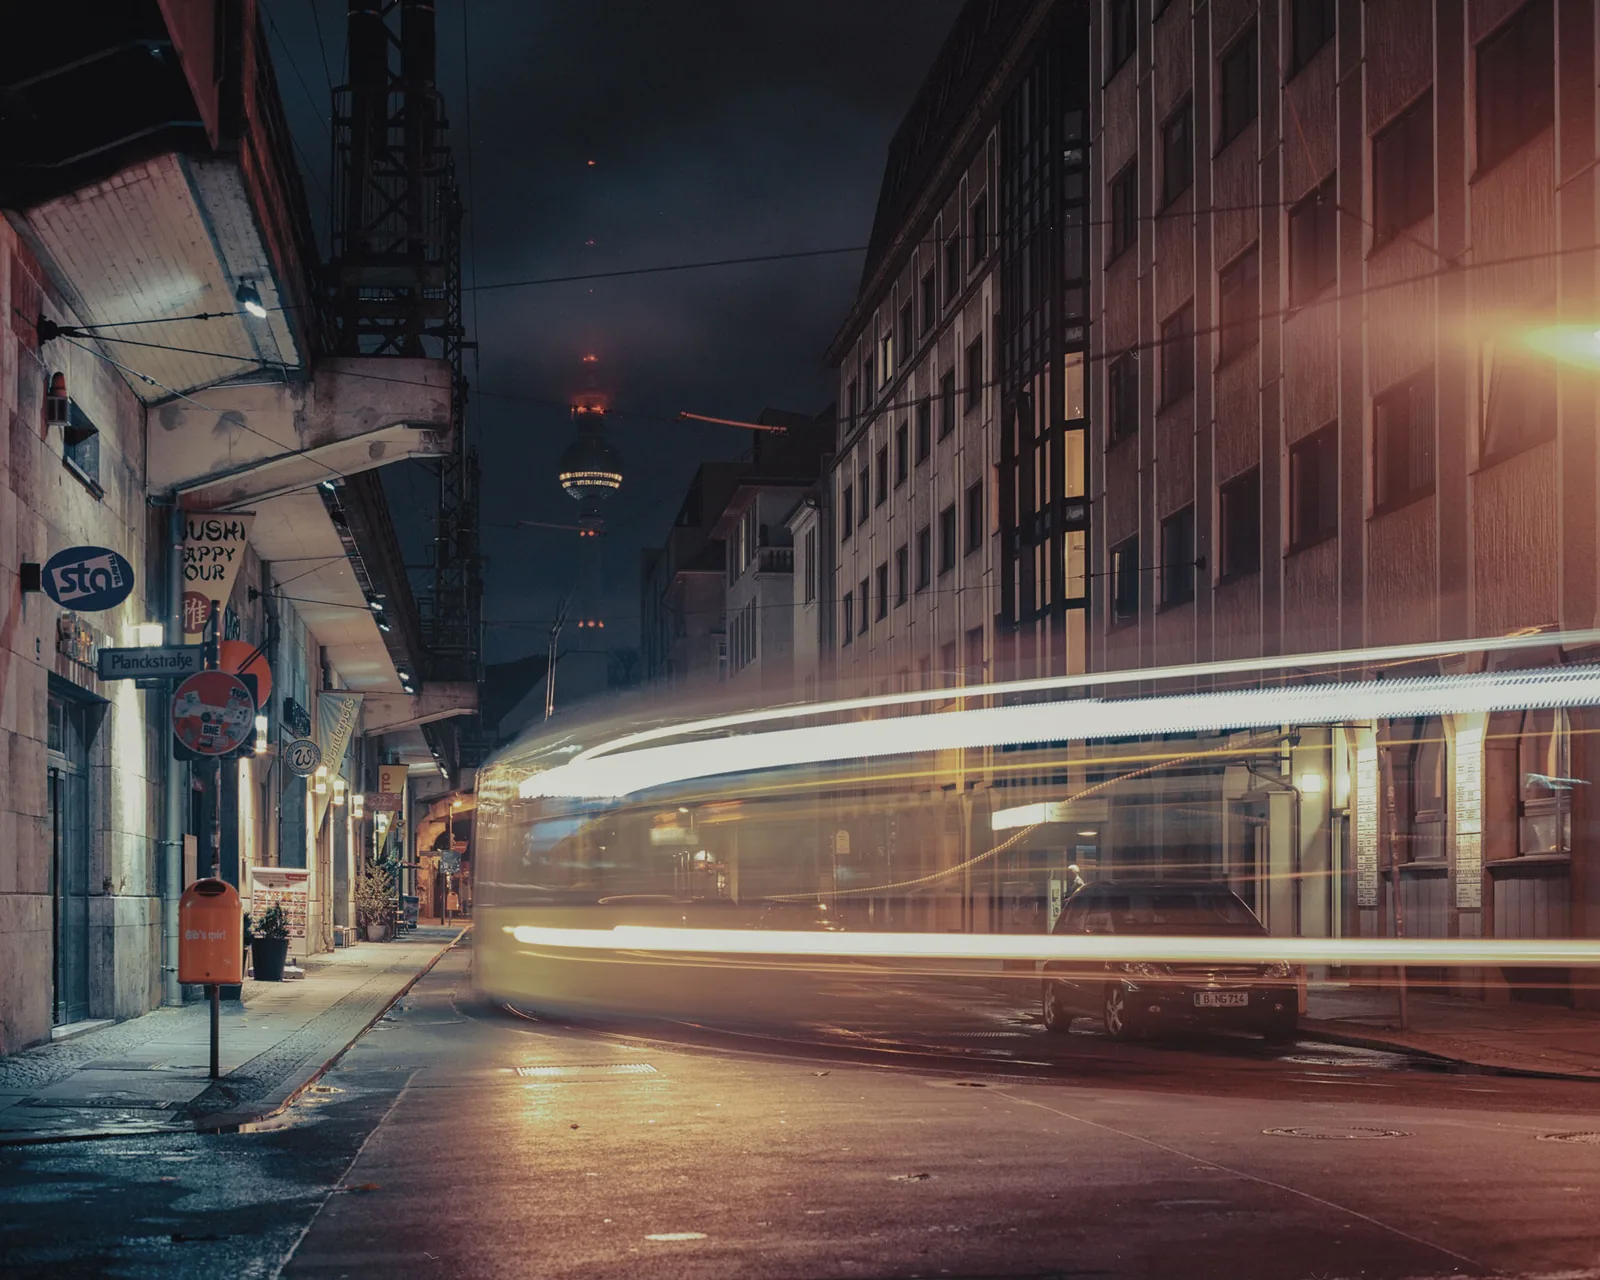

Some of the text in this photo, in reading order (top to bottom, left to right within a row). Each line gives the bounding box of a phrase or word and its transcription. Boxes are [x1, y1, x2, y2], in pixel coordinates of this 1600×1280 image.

[182, 519, 246, 542] USHI
[183, 545, 236, 563] APPY
[59, 562, 112, 594] sta
[107, 554, 123, 587] TRAVEL
[184, 564, 225, 581] OUR
[111, 652, 193, 670] Planckstraße
[381, 772, 391, 793] TTO
[1203, 994, 1210, 1004] B
